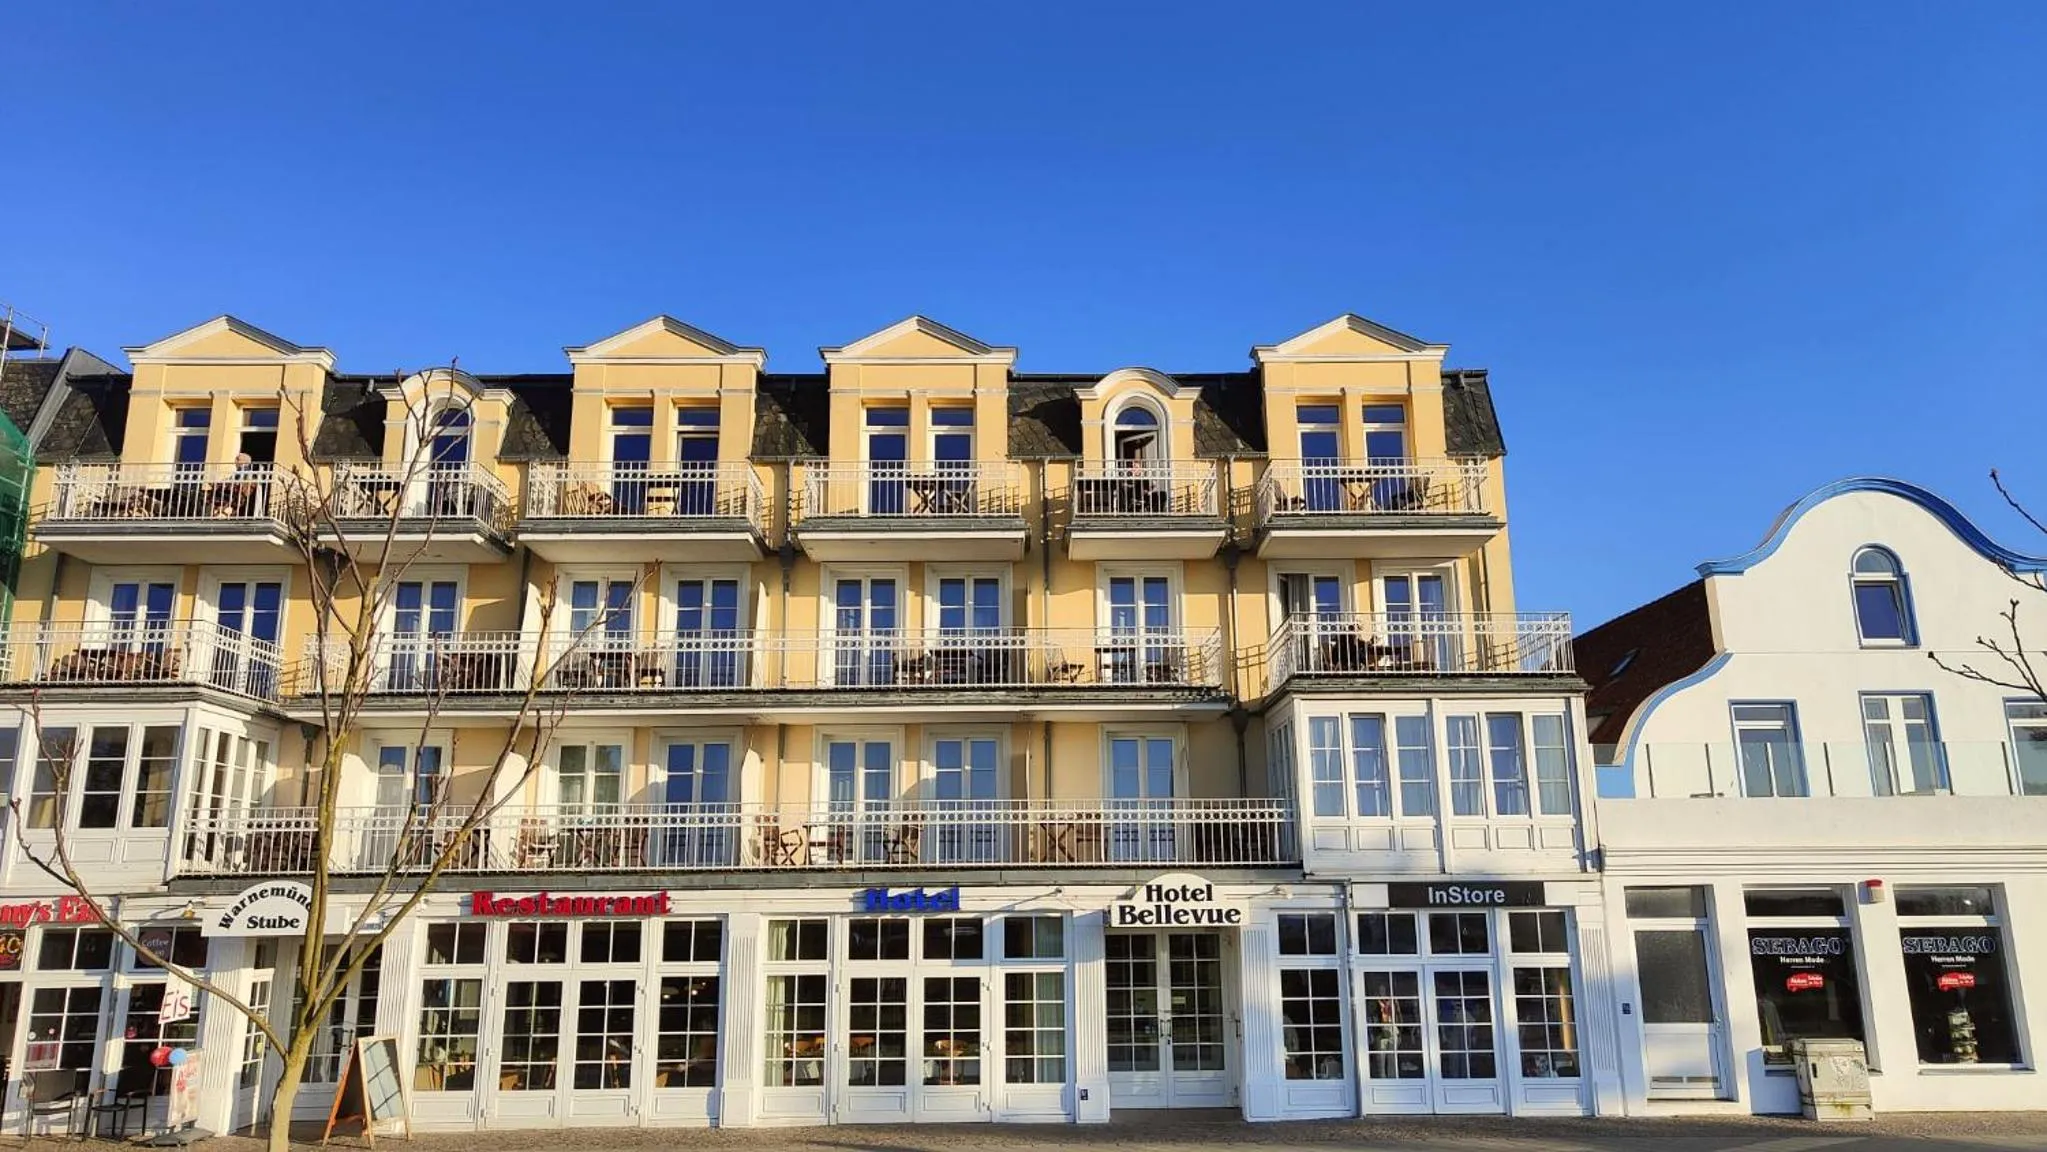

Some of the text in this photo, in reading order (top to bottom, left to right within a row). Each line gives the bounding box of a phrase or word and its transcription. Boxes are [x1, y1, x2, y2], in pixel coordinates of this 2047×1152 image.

[865, 882, 960, 911] Hotel
[1145, 884, 1213, 902] Hotel
[1428, 886, 1506, 904] InStore
[471, 888, 674, 917] Restaurant
[246, 916, 300, 929] Stube
[1118, 904, 1242, 925] Bellevue
[1751, 937, 1846, 955] SEBAGO
[1901, 936, 1996, 954] SEBAGO
[160, 989, 189, 1020] Eis
